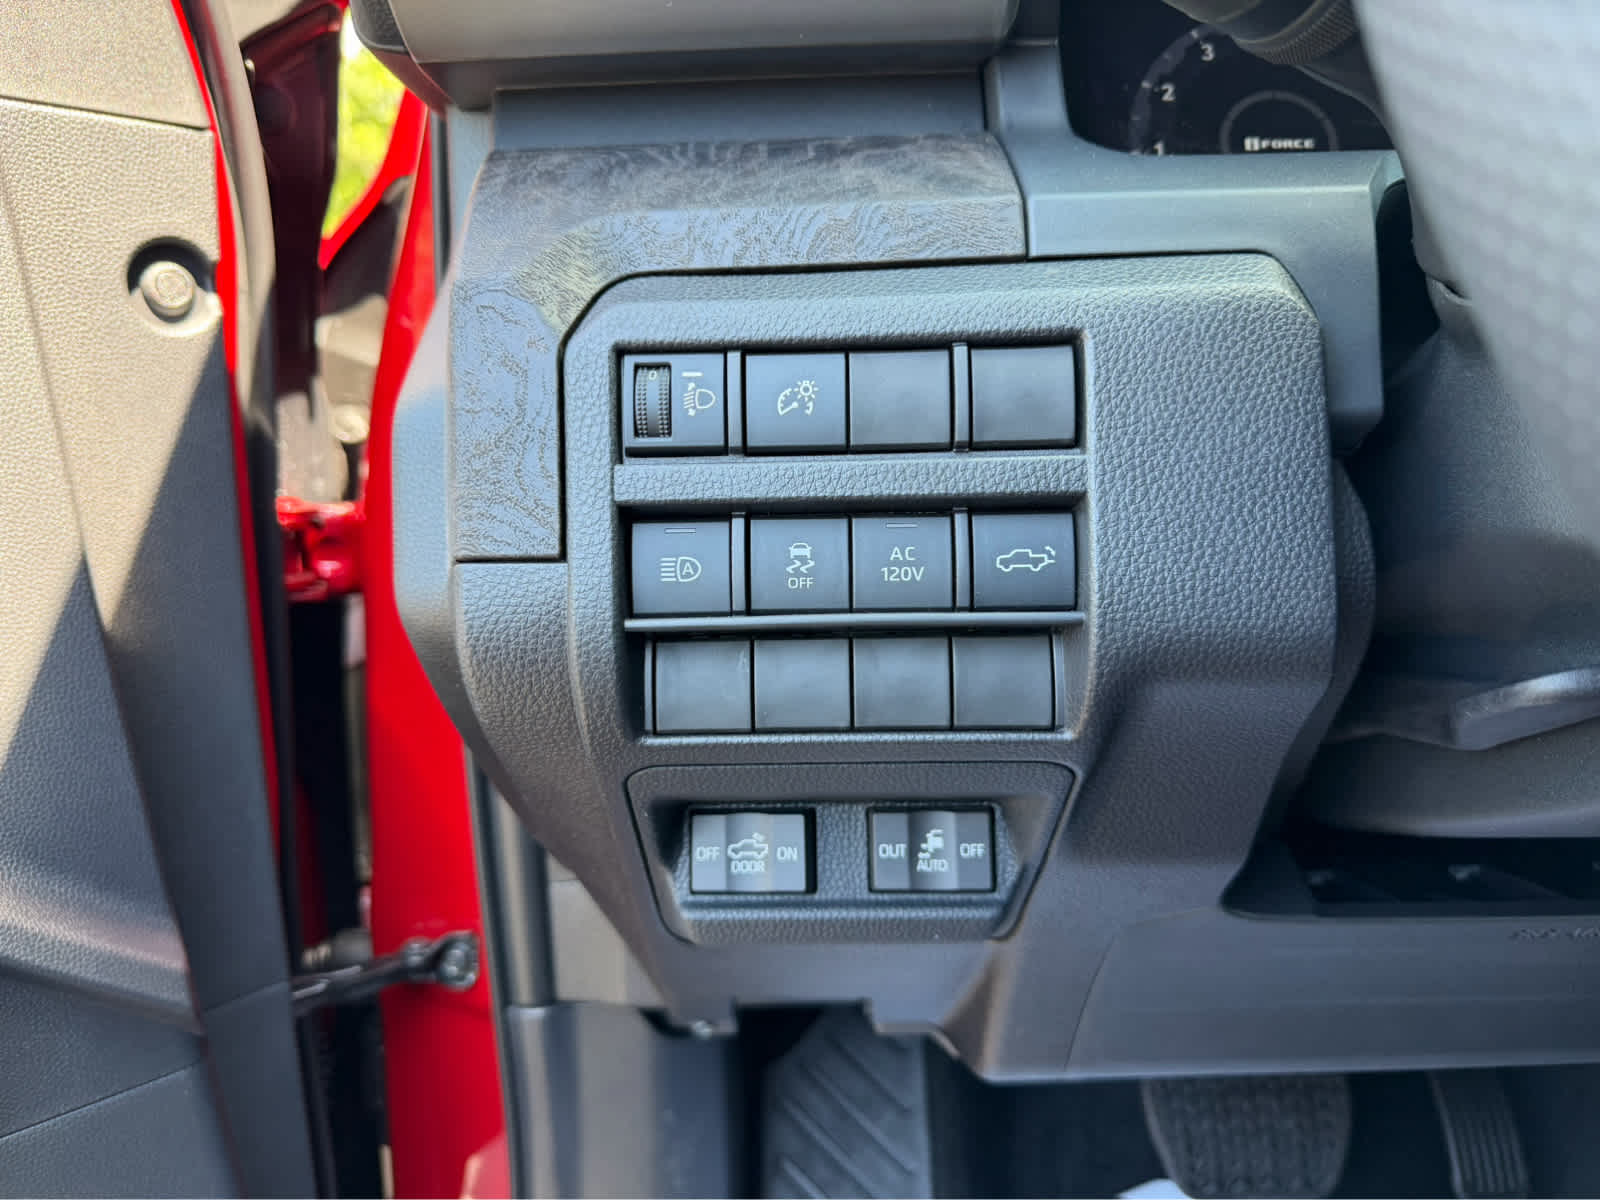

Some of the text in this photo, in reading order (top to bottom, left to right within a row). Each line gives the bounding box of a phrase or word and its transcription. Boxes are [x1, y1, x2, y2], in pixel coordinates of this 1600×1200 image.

[1201, 43, 1216, 61] 3
[1161, 83, 1176, 102] 2
[1153, 141, 1164, 156] 1
[890, 546, 916, 561] AC
[881, 566, 925, 582] 120V
[787, 577, 815, 589] OFF
[696, 846, 720, 862] OFF
[776, 846, 798, 861] ON
[878, 843, 906, 858] OUT
[959, 843, 985, 858] OFF
[730, 860, 765, 873] DOOR
[916, 859, 948, 872] AUTO
